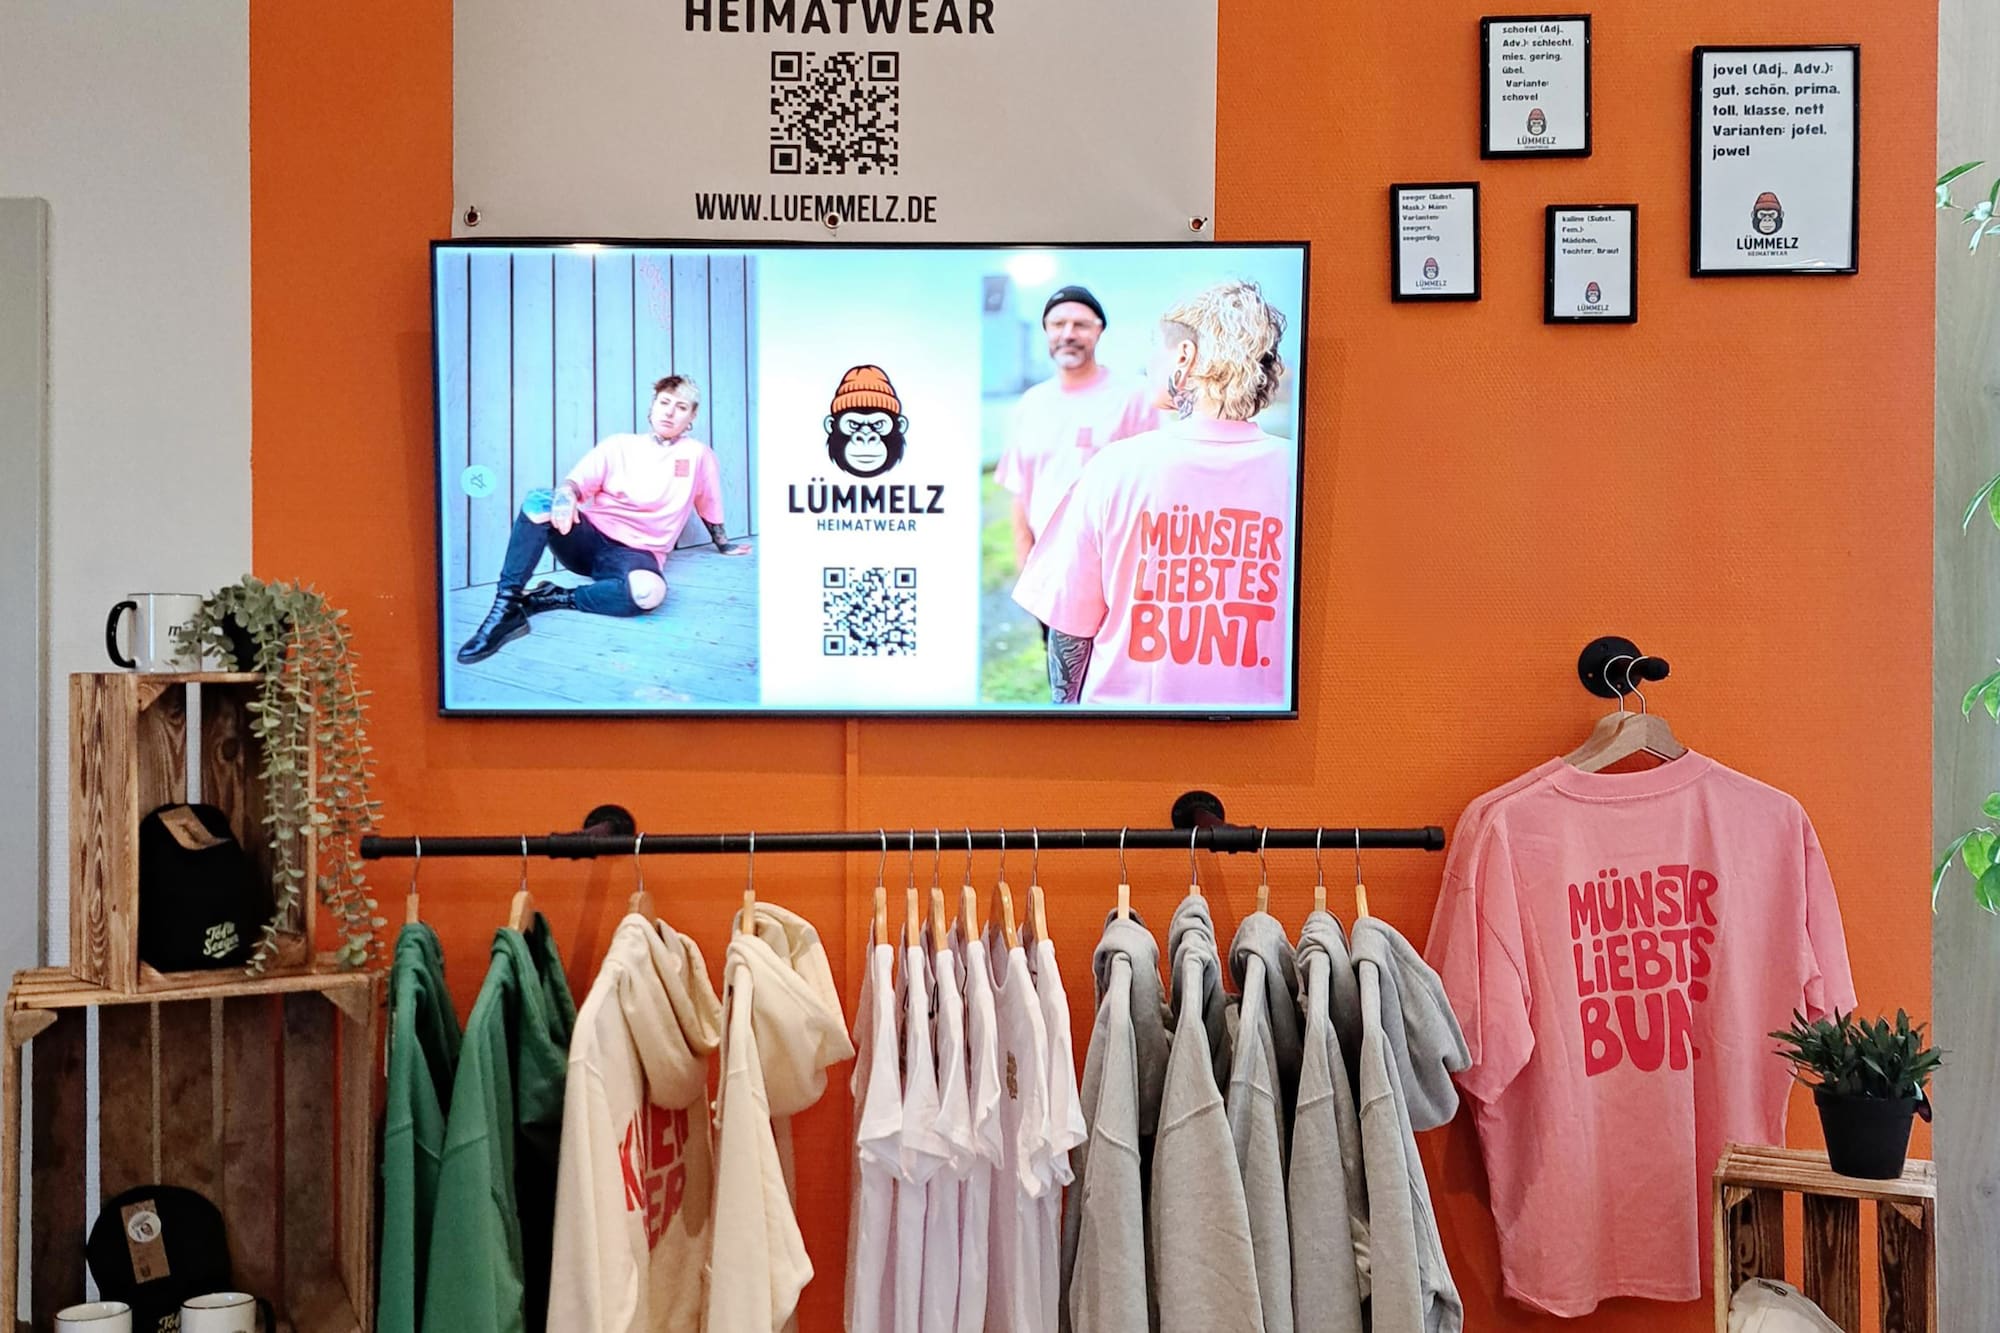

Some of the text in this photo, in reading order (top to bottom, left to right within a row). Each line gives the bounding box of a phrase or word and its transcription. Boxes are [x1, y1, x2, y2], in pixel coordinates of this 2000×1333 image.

[684, 0, 996, 34] HEIMATWEAR
[1713, 63, 1747, 79] jovel
[1793, 62, 1833, 75] Adv.):
[1794, 104, 1825, 115] nett
[1516, 135, 1557, 145] LÜMMELZ
[1712, 125, 1786, 137] Varianten:
[1712, 145, 1751, 160] jowel
[695, 192, 938, 224] WWW.LUEMMELZ.DE
[1736, 234, 1799, 250] LÜMMELZ
[788, 476, 945, 514] LÜMMELZ
[816, 518, 917, 532] HEIMATWEAR
[1141, 504, 1283, 562] MÜNSTER
[1238, 560, 1280, 603] ES
[1128, 602, 1276, 668] BUNT.
[1567, 864, 1719, 941] MÜNSTR
